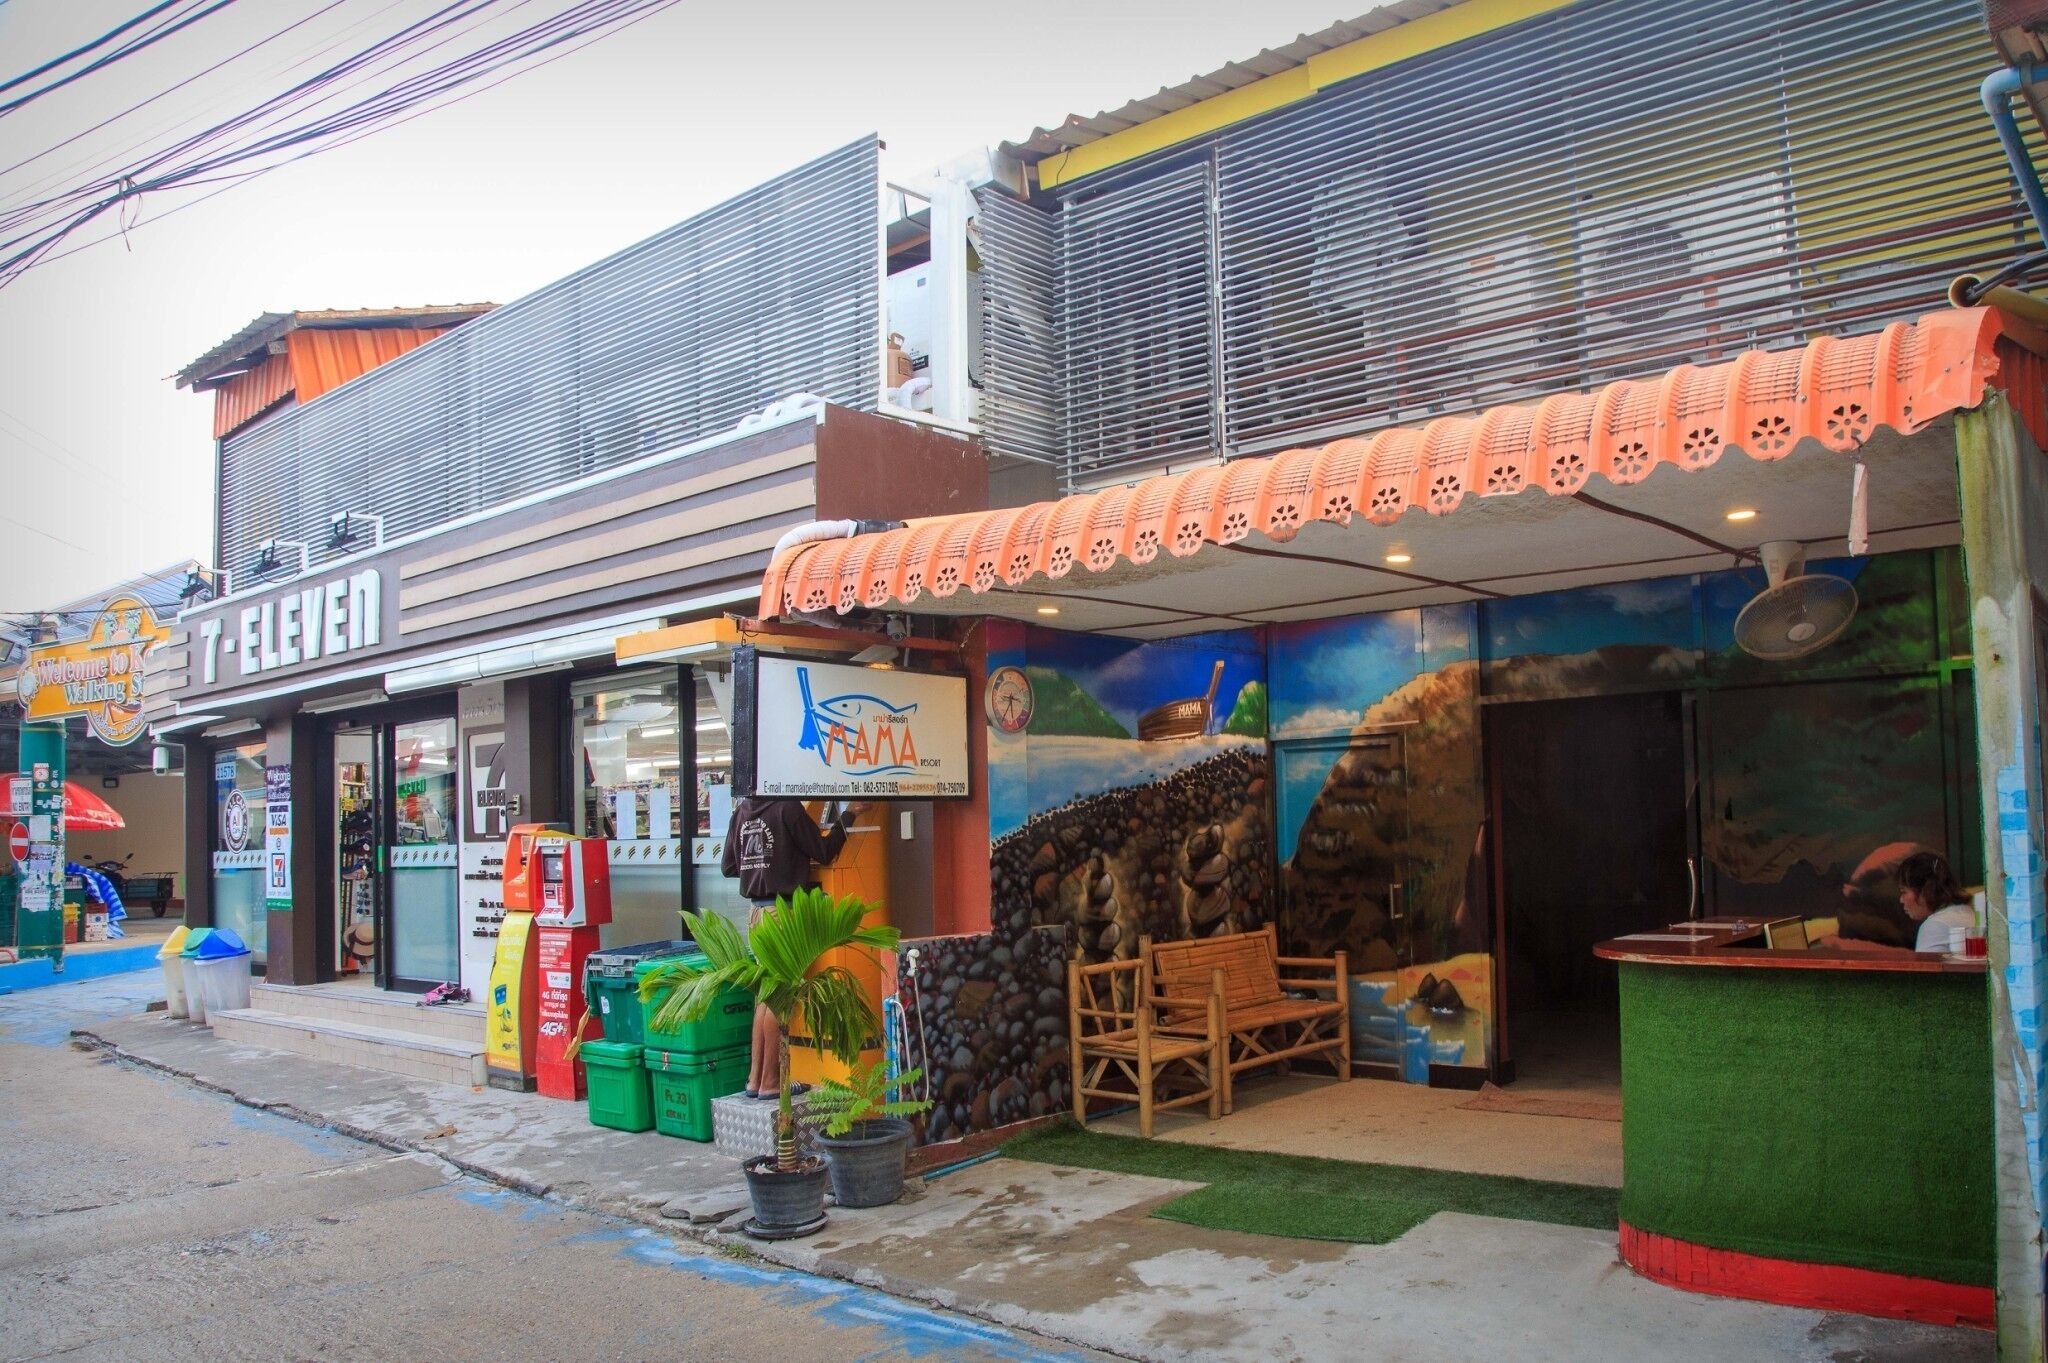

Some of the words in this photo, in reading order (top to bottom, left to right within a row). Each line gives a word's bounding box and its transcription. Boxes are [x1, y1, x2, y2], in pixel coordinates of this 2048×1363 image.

[37, 655, 108, 686] Welcome
[110, 650, 128, 676] to
[65, 680, 127, 706] Walking
[1178, 703, 1201, 717] MAMA
[826, 721, 918, 767] MAMA
[920, 759, 941, 767] RESORT
[271, 814, 287, 826] VISA
